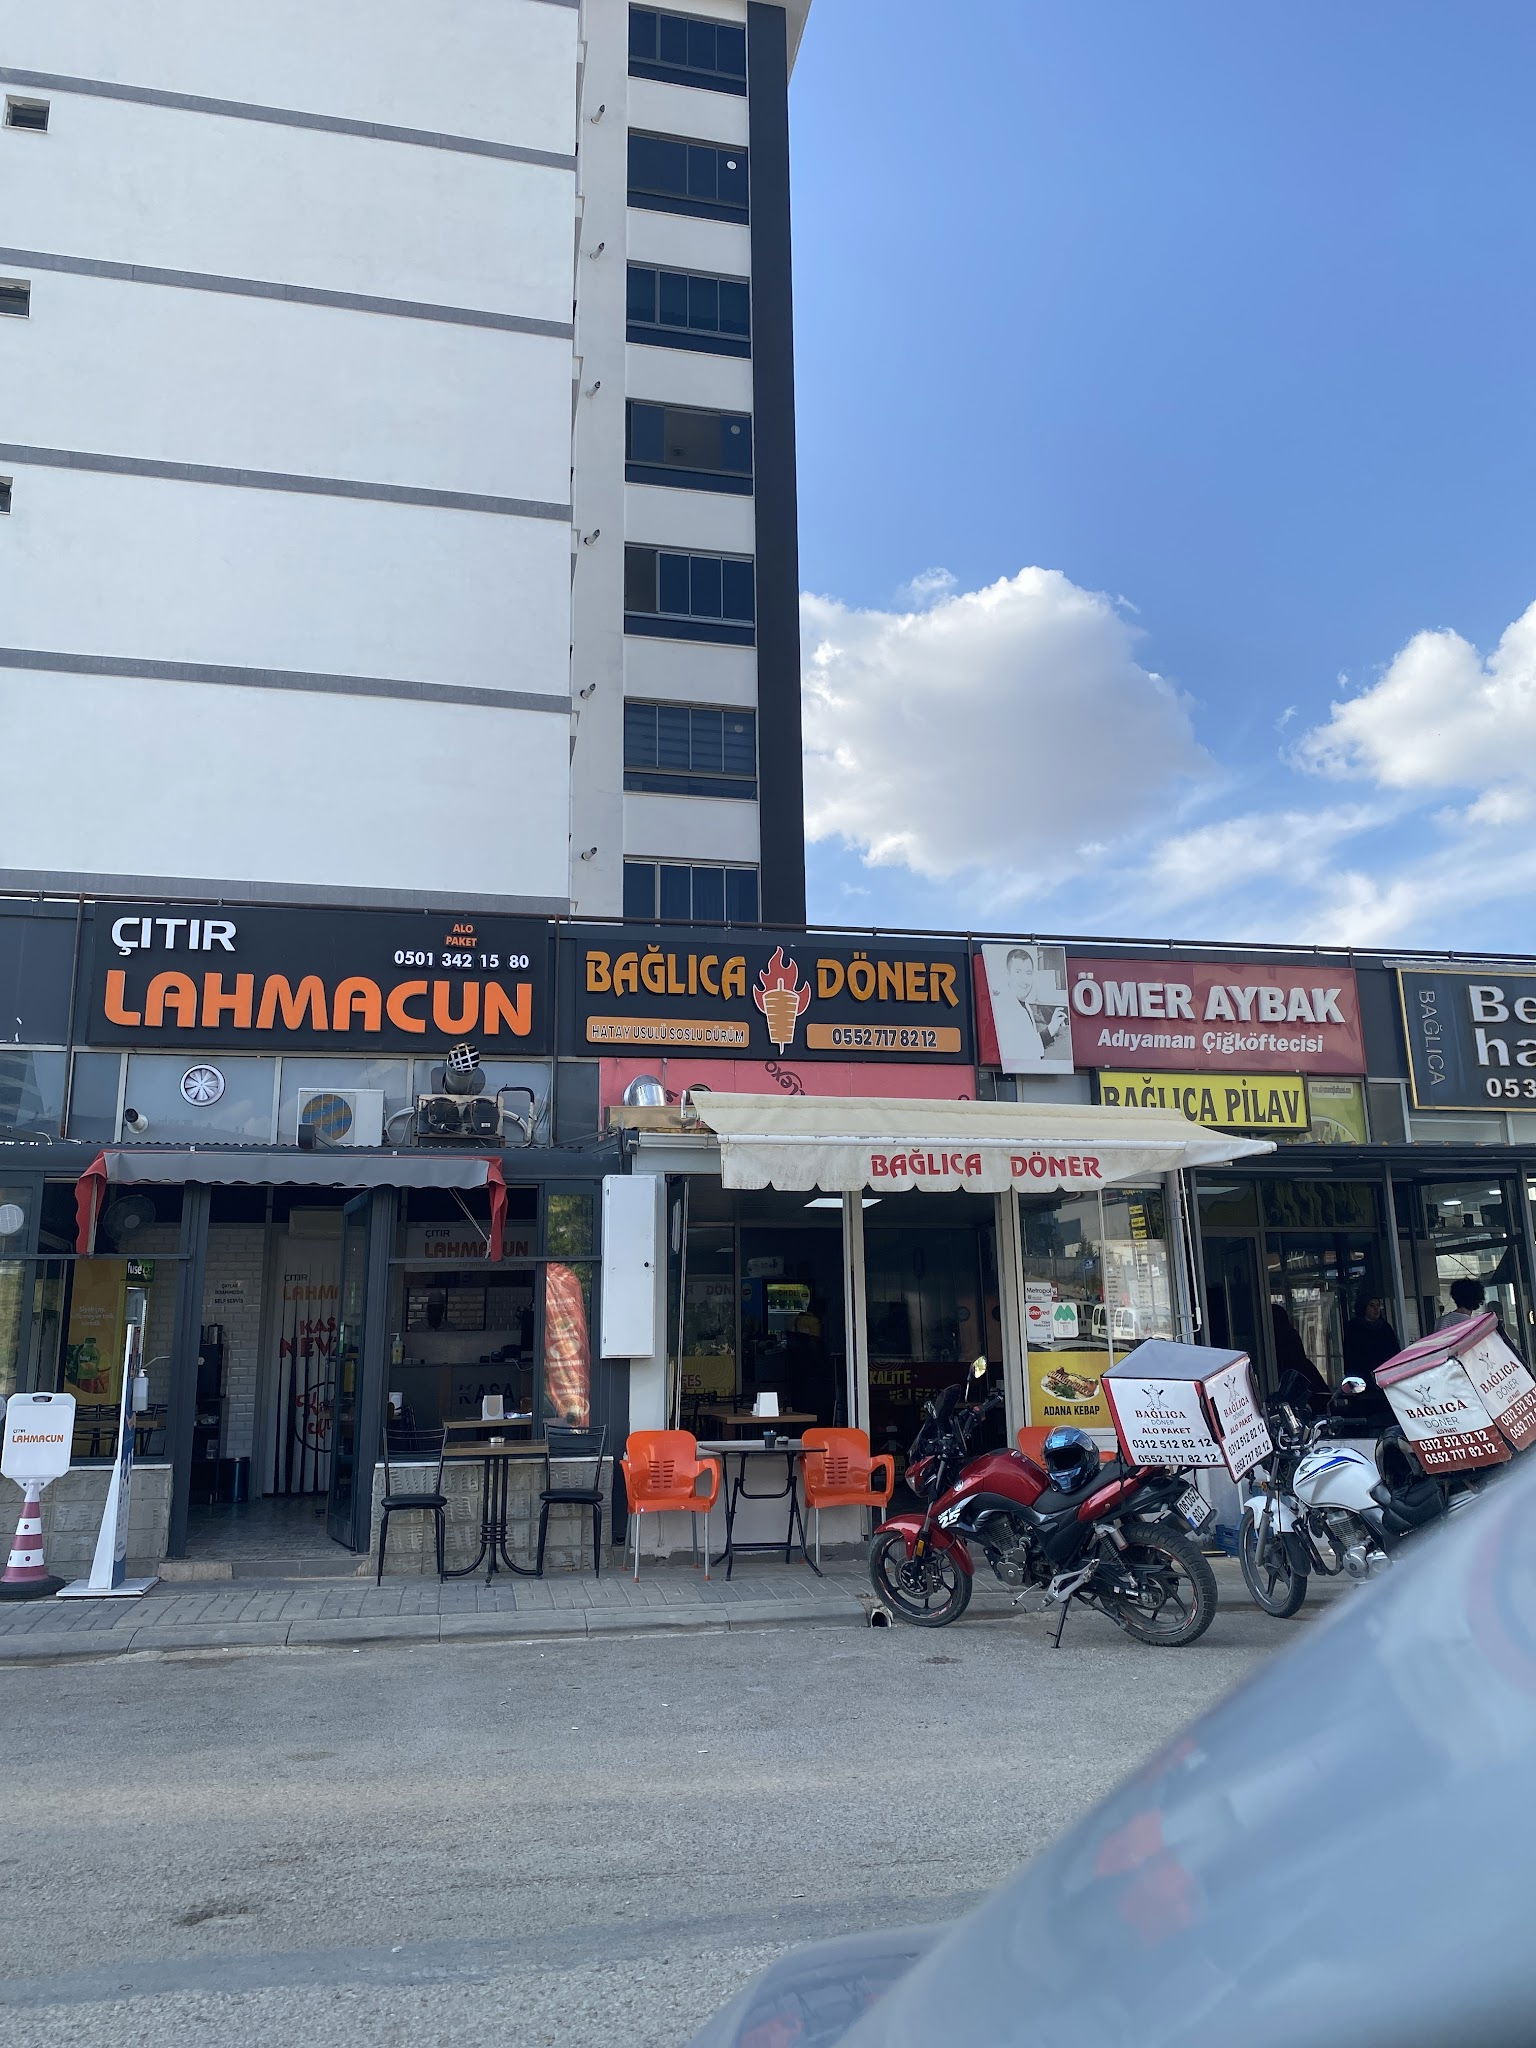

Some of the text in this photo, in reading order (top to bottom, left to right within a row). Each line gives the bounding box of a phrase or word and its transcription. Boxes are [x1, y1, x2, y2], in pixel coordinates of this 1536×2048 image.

[111, 917, 237, 956] ÇITIR
[452, 923, 474, 933] ALO
[445, 935, 478, 947] PAKET
[394, 950, 529, 969] 0501 342 15 80
[586, 943, 960, 1008] BAĞLICA DÖNER
[104, 969, 533, 1036] LAHMACUN
[1072, 972, 1346, 1024] ÖMER AYBAK
[591, 1023, 745, 1044] HATAY USULÜ SOSLU DÜRÜM
[832, 1028, 937, 1048] 0552 717 82 12
[1097, 1028, 1324, 1055] Adıyaman Çiğköftecisi
[1419, 990, 1446, 1086] BAĞLICA
[1224, 1079, 1301, 1123] PİLAV
[870, 1148, 1103, 1179] BAĞLICA DÖNER
[1479, 1360, 1520, 1394] BAĞLICA
[1043, 1405, 1100, 1416] ADANA KEBAP
[1135, 1407, 1187, 1419] BAĞLICA
[1223, 1395, 1250, 1418] BAĞLICA
[1405, 1399, 1468, 1419] BAĞLICA
[1500, 1408, 1519, 1426] 0312
[1514, 1400, 1529, 1415] 512
[12, 1434, 64, 1443] LAHMACUN
[1419, 1429, 1490, 1452] 0312 512 82 12
[1509, 1420, 1528, 1440] 0552
[1132, 1438, 1213, 1449] 0312 512 82 12
[1424, 1443, 1499, 1465] 0552 717 82 12
[1138, 1453, 1219, 1463] 0552 717 82 12
[1178, 1500, 1190, 1514] 06
[1192, 1505, 1206, 1523] 603
